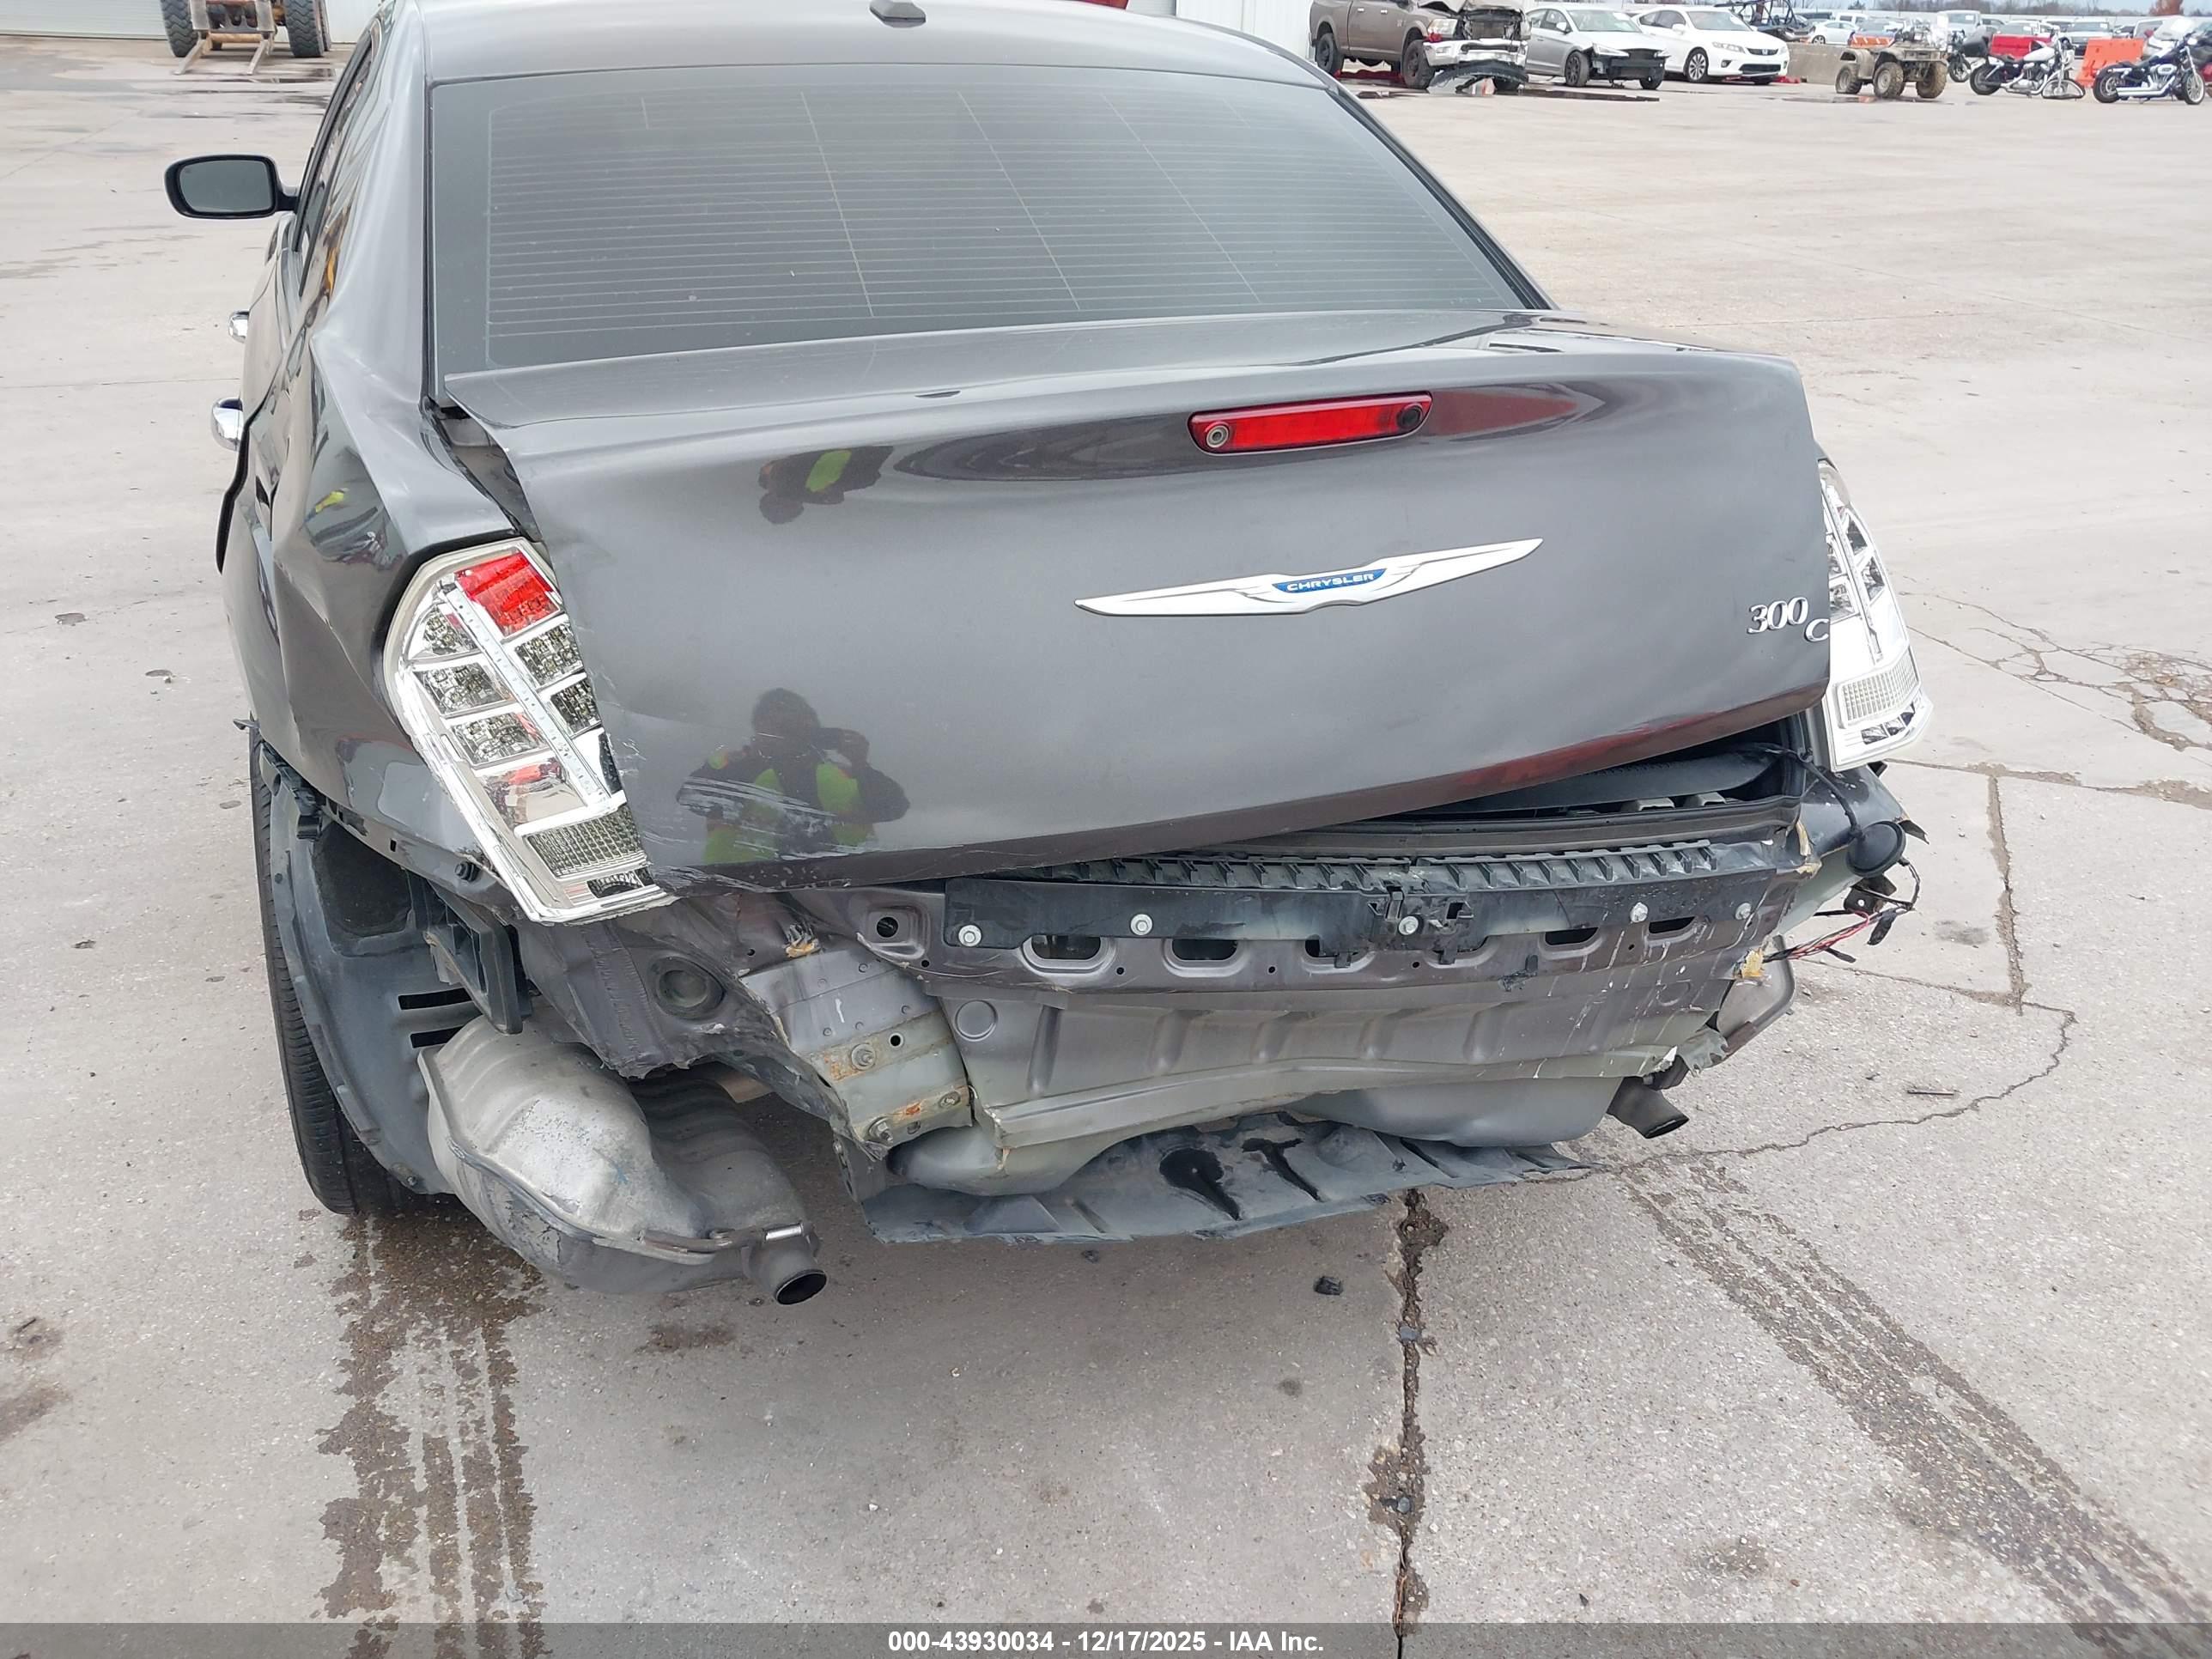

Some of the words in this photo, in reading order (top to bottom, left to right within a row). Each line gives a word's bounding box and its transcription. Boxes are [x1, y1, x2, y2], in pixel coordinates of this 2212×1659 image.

[1286, 573, 1376, 592] CHRYSLER
[1747, 597, 1808, 634] 300
[1805, 618, 1830, 642] C
